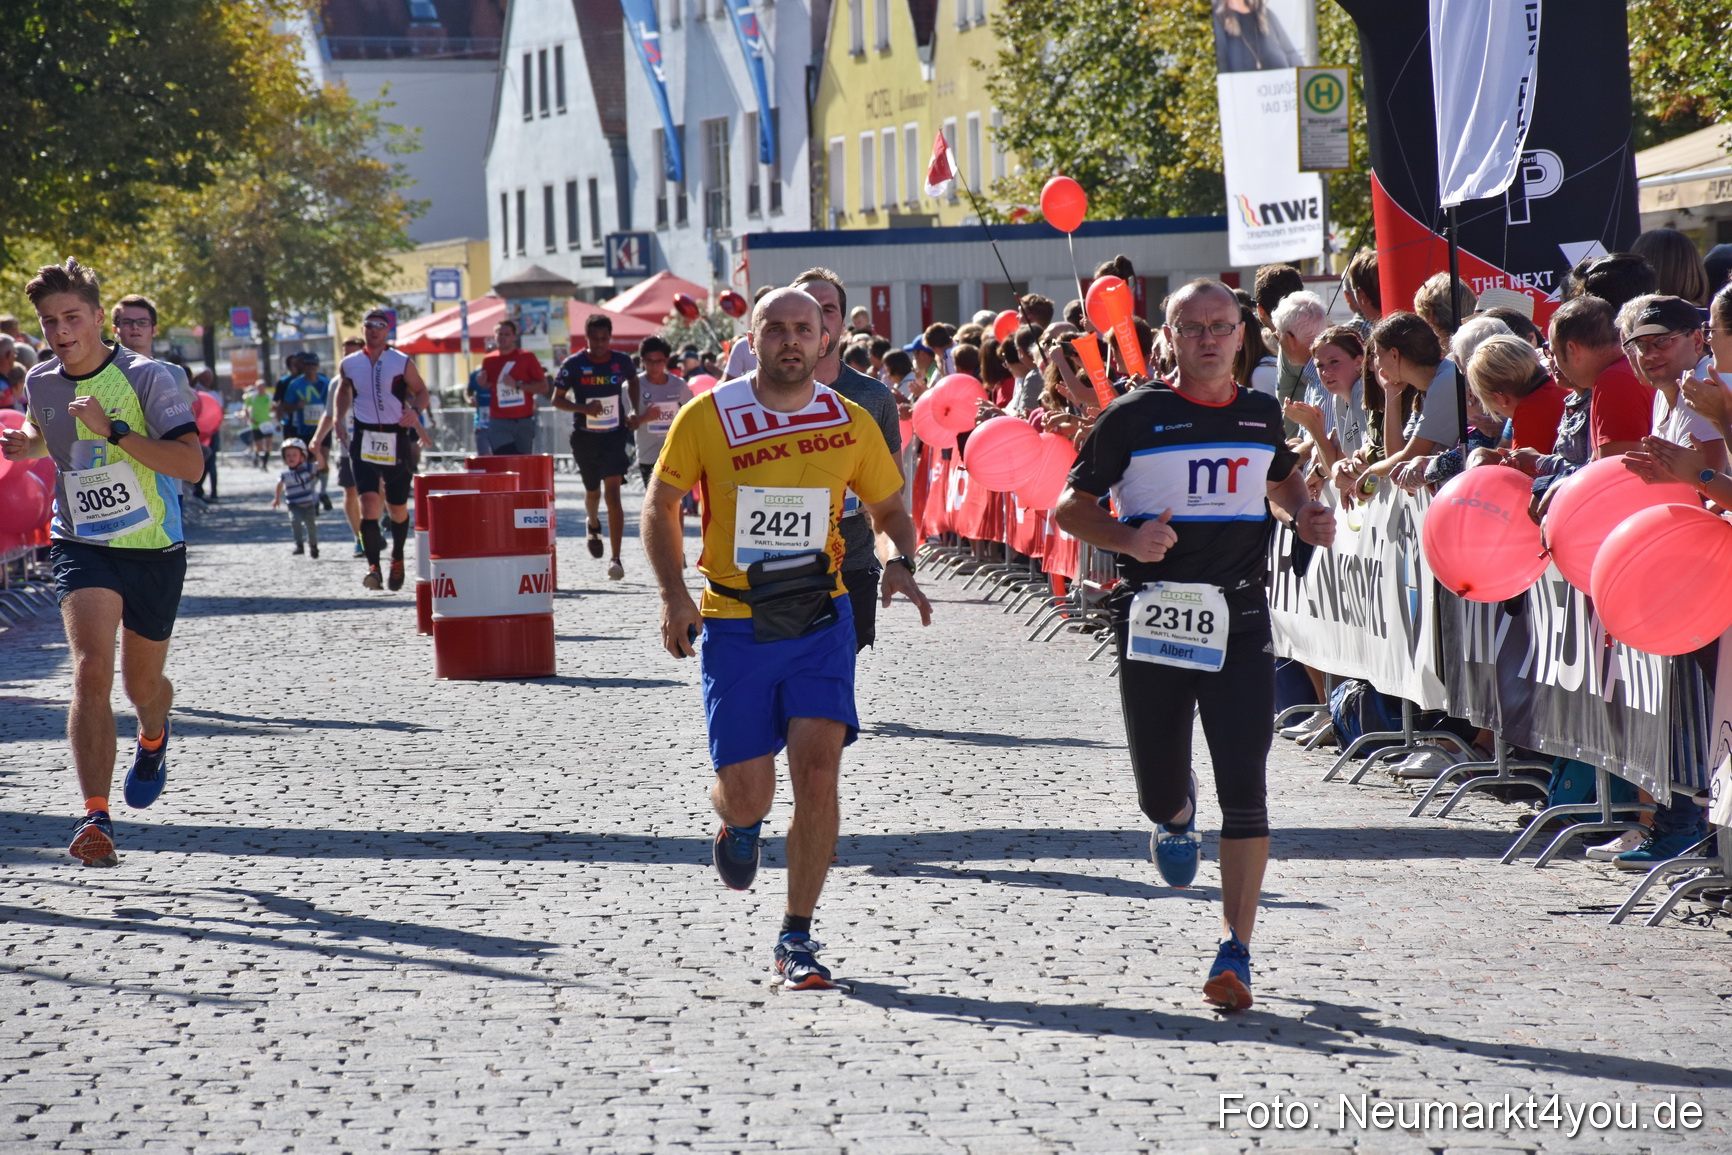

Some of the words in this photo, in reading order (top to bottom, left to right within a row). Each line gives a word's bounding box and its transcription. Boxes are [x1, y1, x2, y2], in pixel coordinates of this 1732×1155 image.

[1315, 83, 1333, 104] H
[1472, 275, 1504, 292] THE
[1509, 271, 1553, 289] NEXT
[1116, 317, 1140, 366] DEHN
[1093, 368, 1117, 407] DEH
[657, 411, 673, 420] 056
[371, 441, 388, 451] 176
[732, 443, 791, 471] MAX
[797, 431, 857, 455] BÖGL
[80, 472, 111, 484] BOCK
[76, 483, 130, 512] 3083
[764, 495, 803, 504] BOCK
[750, 511, 811, 537] 2421
[431, 573, 457, 598] VIA
[1161, 590, 1203, 602] BOCK
[1145, 605, 1214, 634] 2318
[1150, 630, 1170, 638] PARTL
[1171, 634, 1199, 642] Neumarkt
[1160, 643, 1194, 659] Albert
